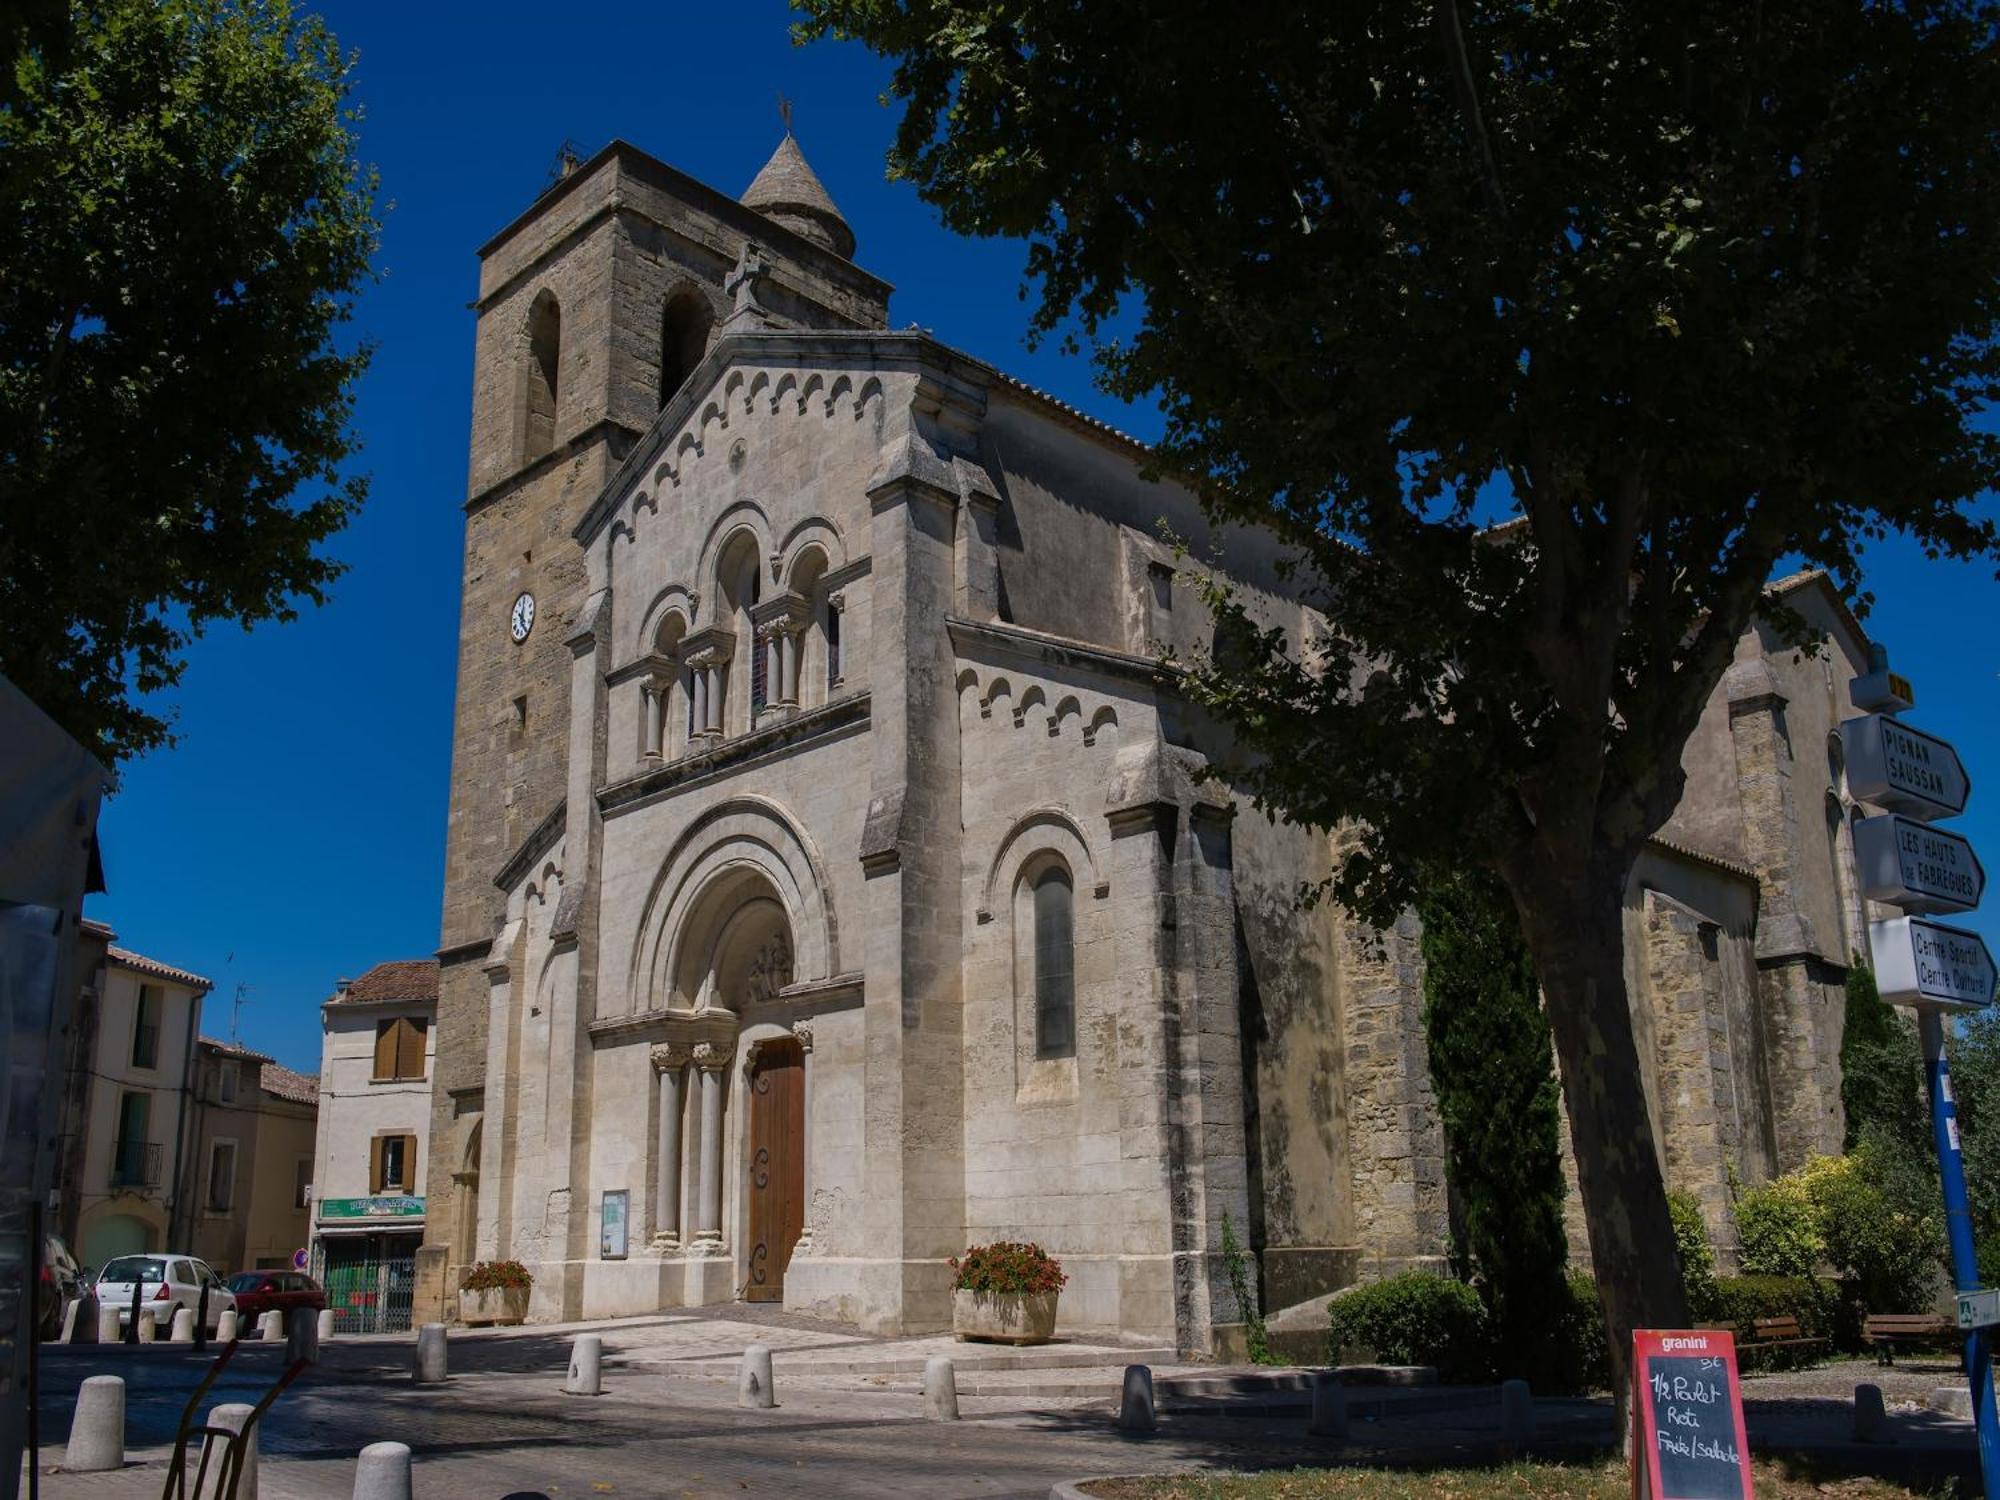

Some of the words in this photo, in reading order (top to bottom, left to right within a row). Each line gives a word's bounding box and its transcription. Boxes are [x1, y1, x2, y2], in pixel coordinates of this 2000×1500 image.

[1885, 730, 1930, 765] PIGNAN
[1890, 758, 1944, 795] SAUSSAN
[1901, 830, 1919, 854] LES
[1925, 840, 1956, 864] HAUTS
[1916, 933, 1946, 960] Centre
[1949, 941, 1978, 966] Sportif
[1920, 962, 1950, 987] Centre
[1953, 970, 1986, 996] Culturel
[1661, 1336, 1708, 1352] granini
[1674, 1376, 1721, 1403] Poulet
